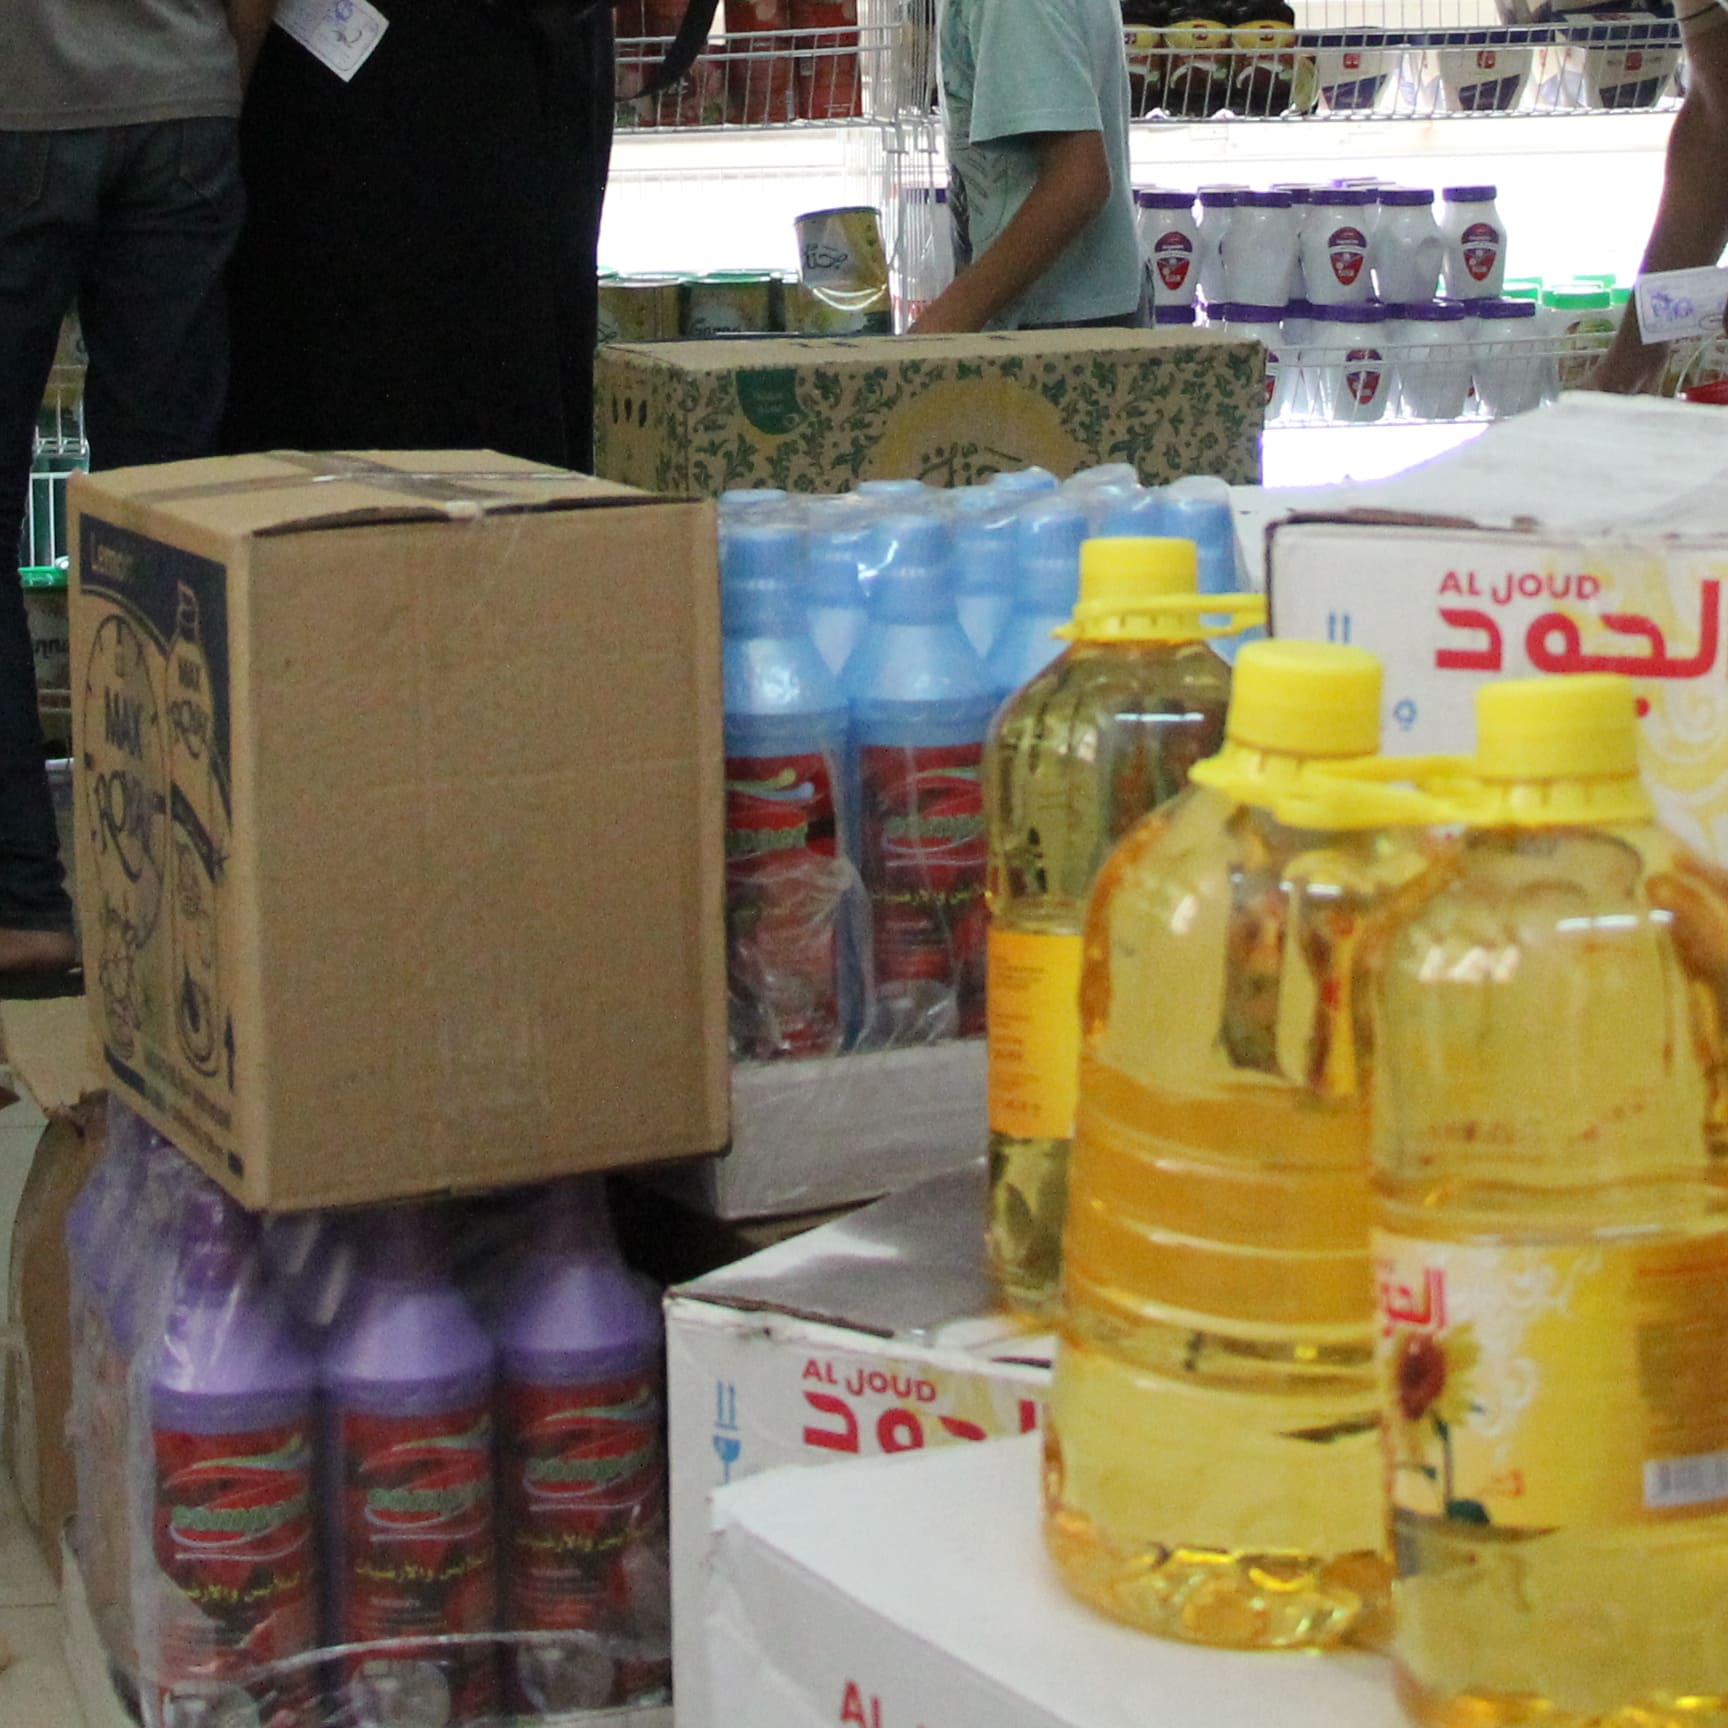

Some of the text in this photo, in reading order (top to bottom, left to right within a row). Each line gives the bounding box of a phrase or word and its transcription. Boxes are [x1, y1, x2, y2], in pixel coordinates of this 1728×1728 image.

[1438, 571, 1601, 606] AL JOUD
[103, 684, 144, 762] MAX
[802, 1358, 938, 1404] AL JOUD
